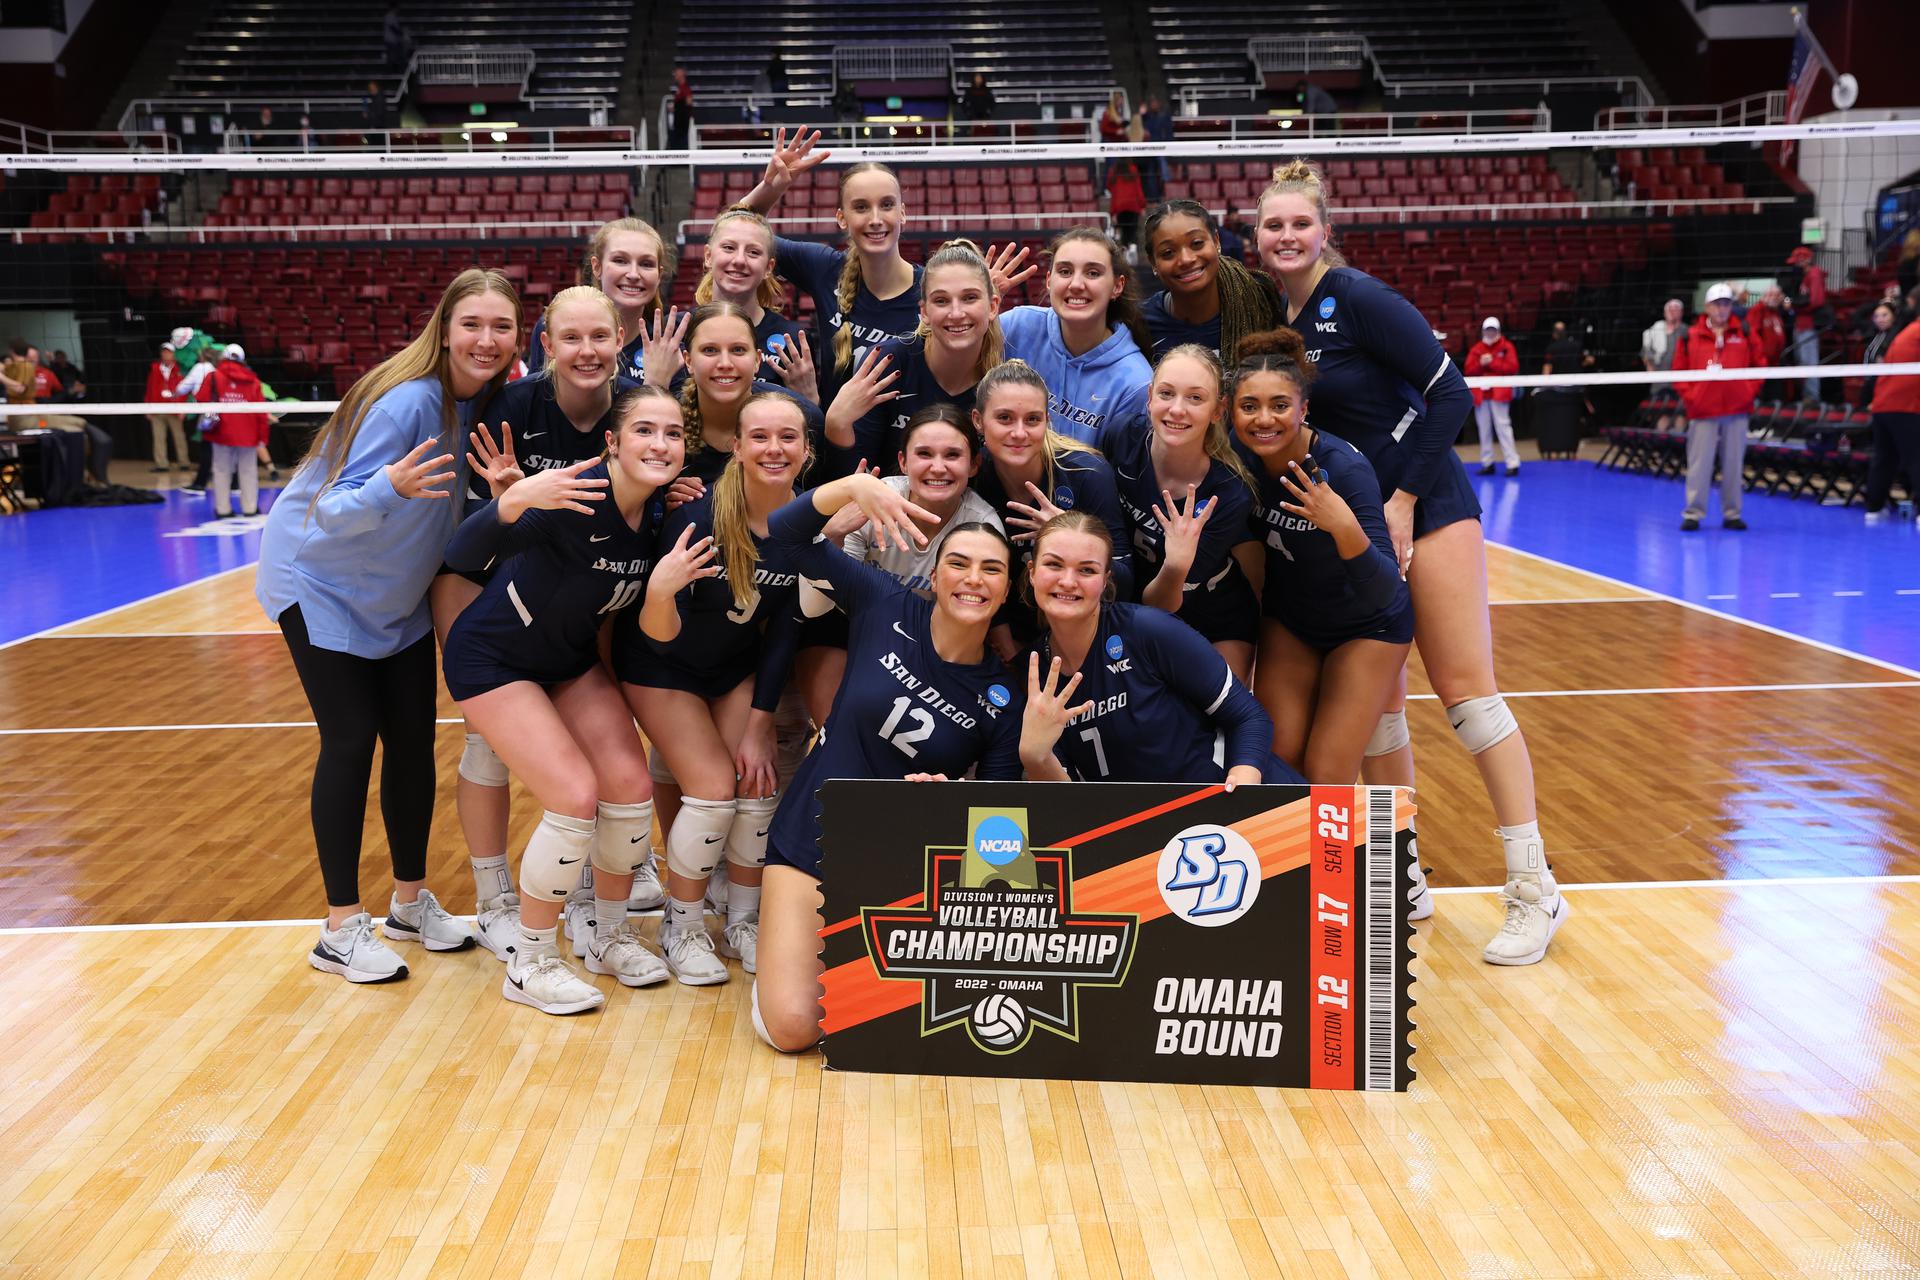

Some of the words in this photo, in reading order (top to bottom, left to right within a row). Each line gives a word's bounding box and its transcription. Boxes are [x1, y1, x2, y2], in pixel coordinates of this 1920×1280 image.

[1314, 322, 1338, 333] WCC
[629, 366, 646, 380] WC
[591, 557, 627, 574] SAN
[596, 579, 642, 615] 10
[1106, 657, 1133, 675] WCC
[879, 651, 922, 690] SAN
[917, 686, 977, 730] DIEGO
[878, 695, 936, 759] 12
[1079, 726, 1110, 777] 7
[1317, 803, 1349, 841] 22
[978, 839, 1022, 853] NCAA
[1324, 841, 1343, 874] SEAT
[943, 892, 995, 902] DIVISION
[996, 892, 1002, 903] I
[1005, 893, 1054, 904] WOMEN'S
[1317, 893, 1349, 927] 17
[938, 905, 1059, 929] VOLLEYBALL
[887, 929, 1118, 964] CHAMPIONSHIP
[1324, 926, 1343, 957] ROW
[955, 978, 988, 990] 2022
[998, 980, 1044, 991] OMAHA
[1153, 977, 1283, 1017] OMAHA
[1317, 974, 1349, 1010] 12
[1155, 1018, 1283, 1058] BOUND
[1324, 1010, 1343, 1067] SECTION
